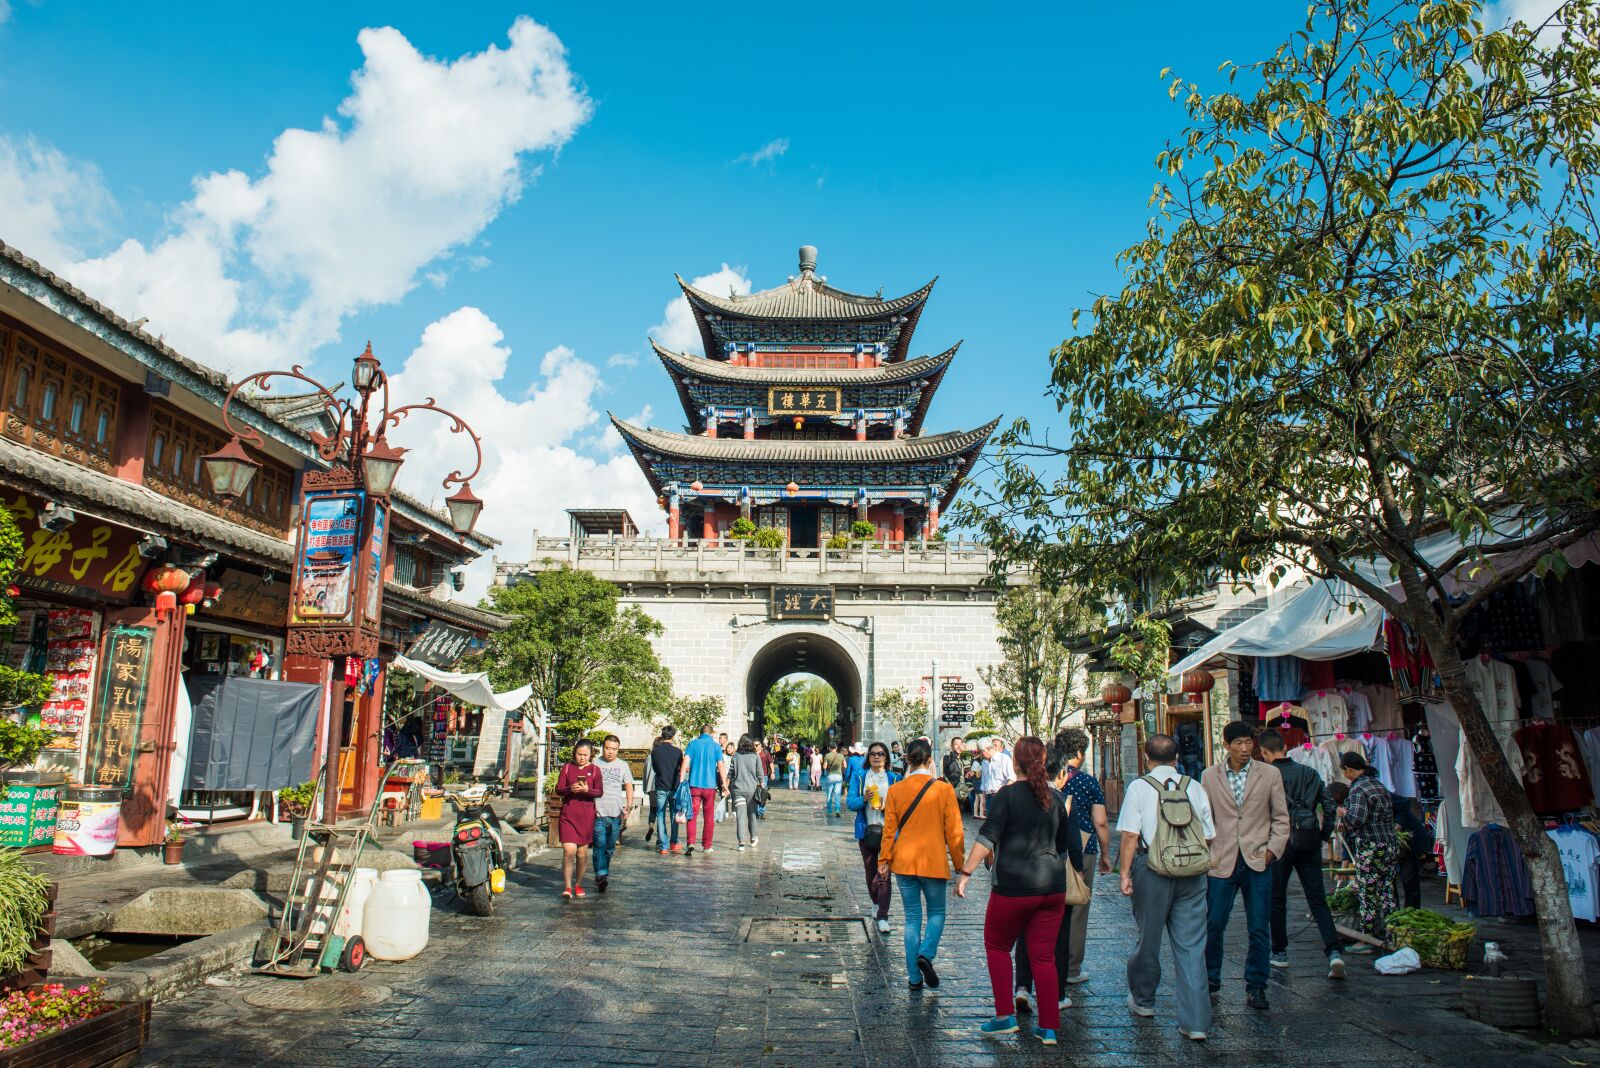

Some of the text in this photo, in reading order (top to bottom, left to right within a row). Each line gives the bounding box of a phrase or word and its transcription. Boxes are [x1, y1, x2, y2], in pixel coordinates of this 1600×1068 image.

[23, 576, 49, 589] PLUM
[51, 582, 76, 594] SHOP
[98, 638, 143, 782] 楊家乳扇乳餅
